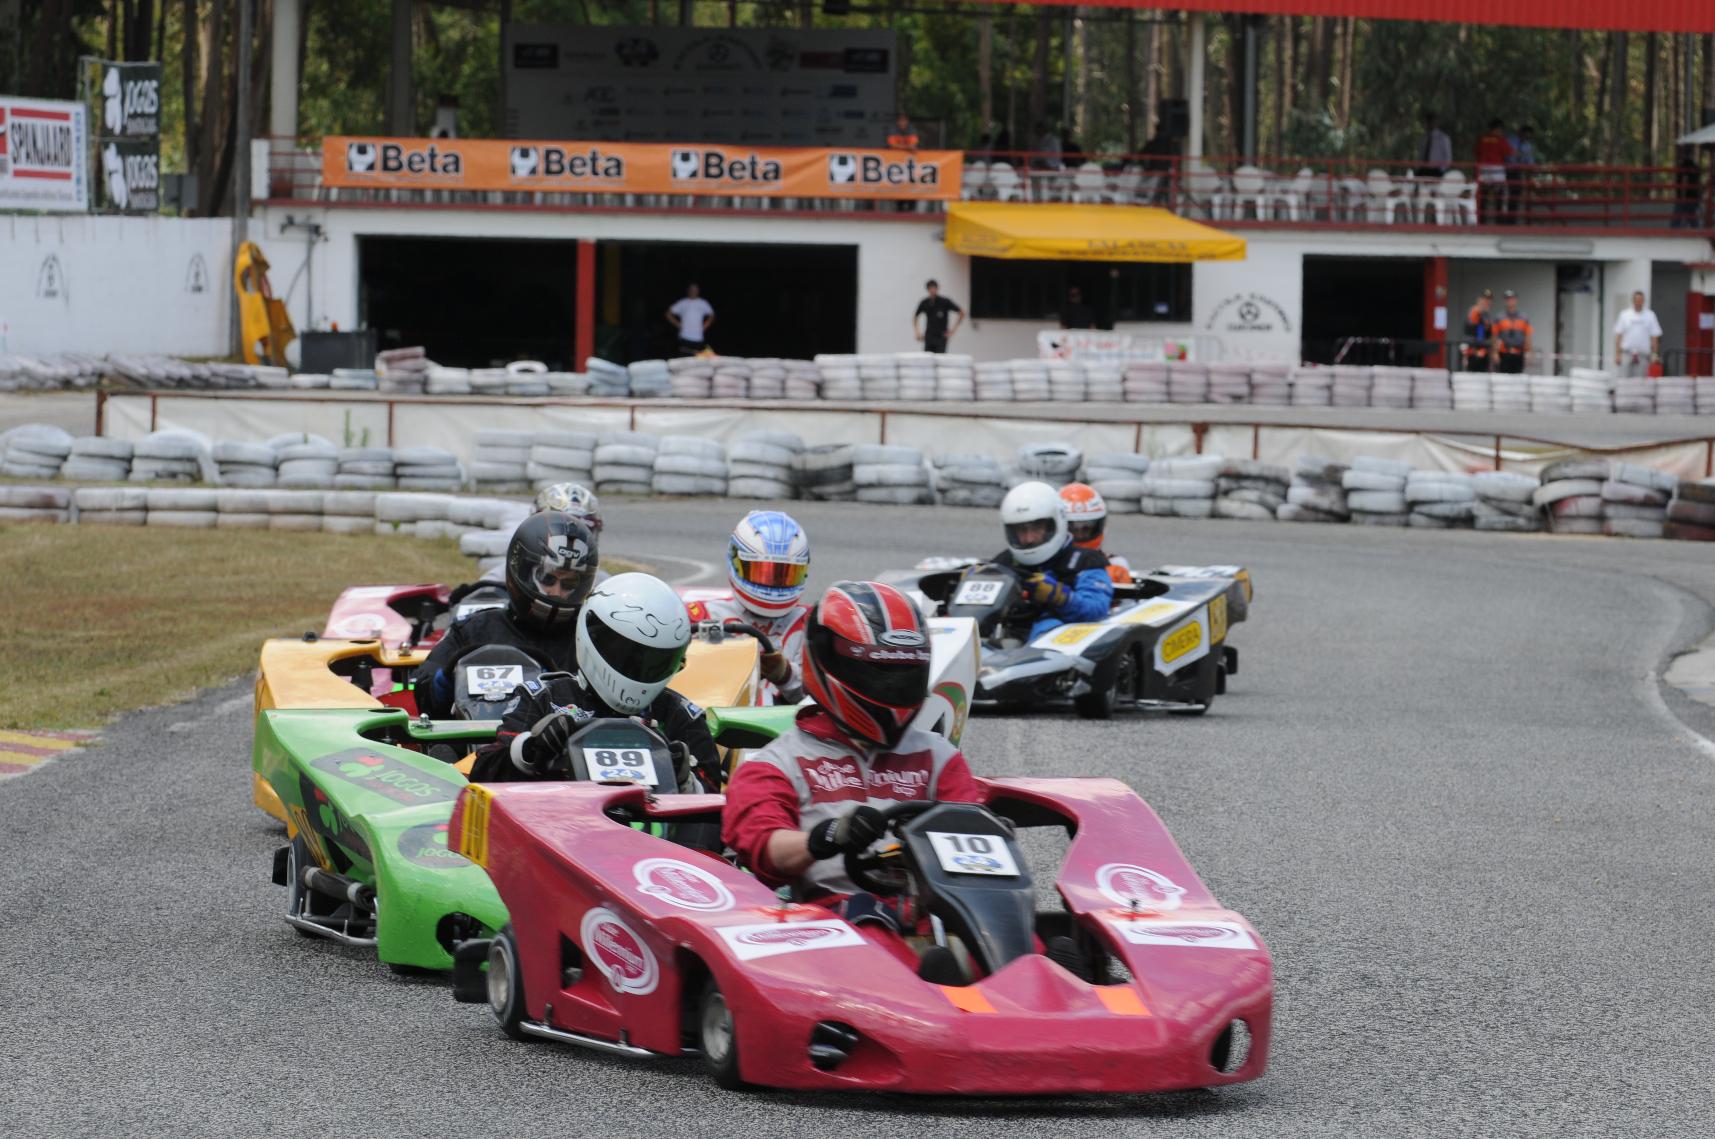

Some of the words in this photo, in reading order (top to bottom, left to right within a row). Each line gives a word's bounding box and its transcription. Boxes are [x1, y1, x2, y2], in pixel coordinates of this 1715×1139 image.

[11, 122, 72, 168] SPANJAARD
[381, 145, 461, 173] Beta
[544, 148, 623, 177] Beta
[703, 152, 781, 181] Beta
[862, 156, 937, 184] Beta
[476, 667, 514, 680] 67
[595, 750, 645, 768] 89
[374, 769, 441, 798] JOGOS
[943, 835, 993, 855] 10
